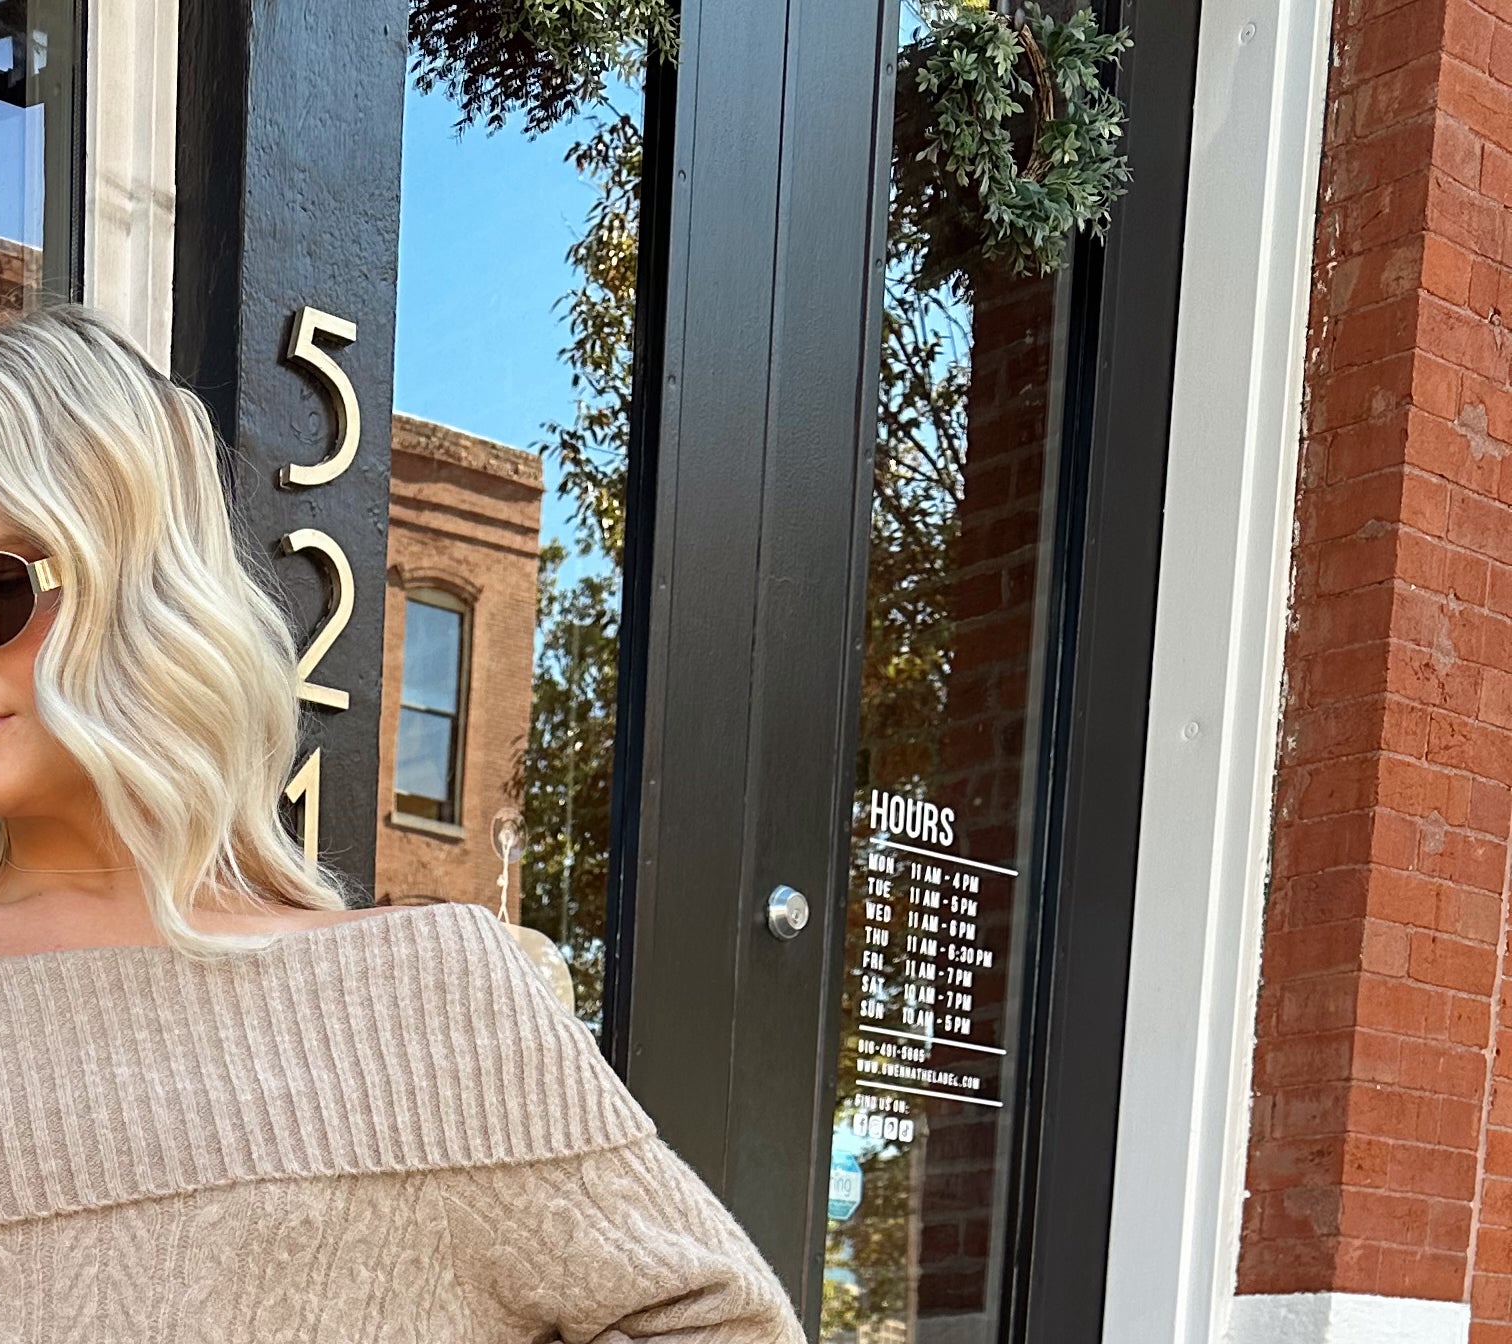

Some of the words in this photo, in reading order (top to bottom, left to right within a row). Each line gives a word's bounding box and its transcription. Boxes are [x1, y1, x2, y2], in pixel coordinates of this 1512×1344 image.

[870, 790, 955, 846] HOURS
[868, 853, 895, 874] MON
[911, 863, 921, 880] 11
[924, 866, 942, 884] AM
[953, 873, 960, 889] 4
[963, 875, 979, 893] PM
[867, 877, 891, 898] TUE
[910, 887, 920, 904] 11
[923, 889, 940, 908] AM
[951, 896, 958, 912] 5
[961, 898, 978, 917] PM
[866, 902, 892, 923] WED
[908, 911, 918, 928] 11
[921, 914, 939, 933] AM
[950, 920, 957, 937] 6
[959, 921, 976, 941] PM
[865, 926, 889, 947] THU
[907, 935, 917, 952] 11
[920, 938, 937, 957] AM
[948, 944, 975, 963] 6:30
[976, 950, 993, 968] PM
[863, 951, 884, 970] FRI
[905, 960, 915, 977] 11
[919, 962, 936, 981] AM
[947, 967, 954, 984] 7
[956, 969, 973, 987] PM
[862, 975, 885, 994] SAT
[904, 983, 915, 1000] 10
[918, 986, 935, 1004] AM
[947, 991, 954, 1008] 7
[955, 992, 972, 1011] PM
[860, 1000, 884, 1019] SUN
[903, 1007, 914, 1024] 10
[917, 1009, 934, 1028] AM
[945, 1015, 952, 1031] 5
[954, 1016, 971, 1035] PM
[855, 1094, 877, 1111] FIND
[879, 1097, 892, 1112] US
[893, 1099, 910, 1114] ON:
